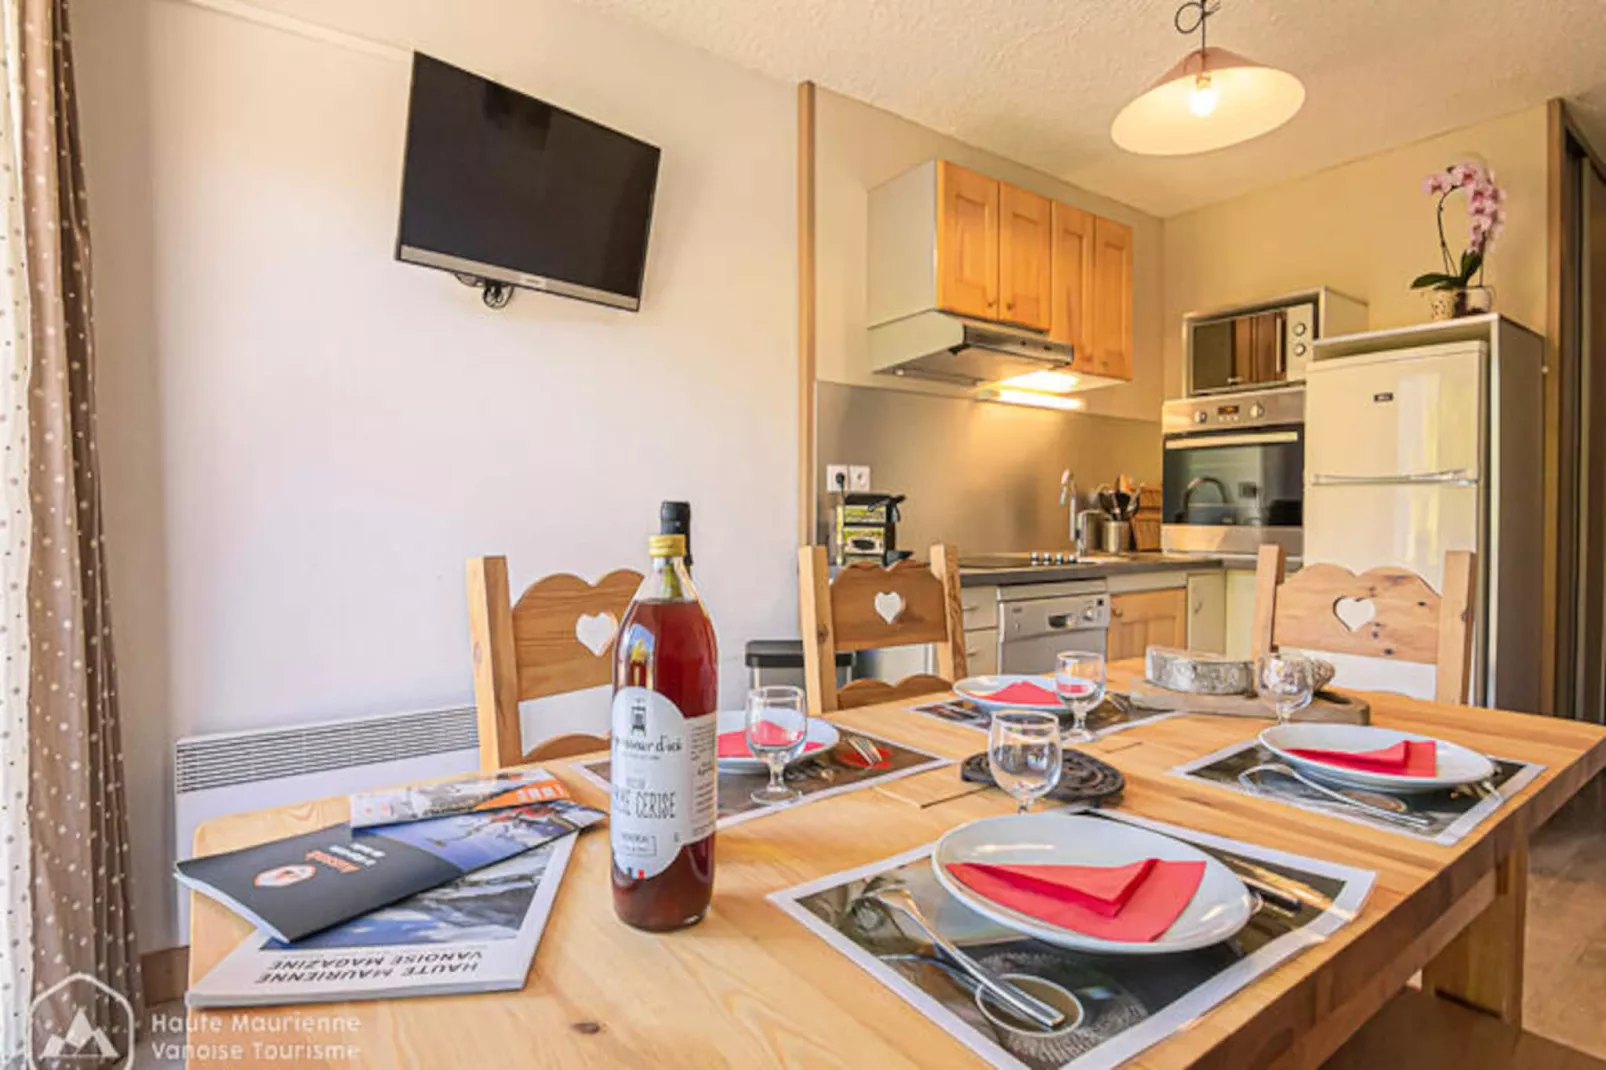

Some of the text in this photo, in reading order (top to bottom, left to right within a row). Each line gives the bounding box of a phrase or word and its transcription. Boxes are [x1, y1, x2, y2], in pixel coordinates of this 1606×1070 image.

[267, 951, 483, 970] VANOISE MAGAZINE
[255, 962, 478, 984] HAUTE MAURIENNE
